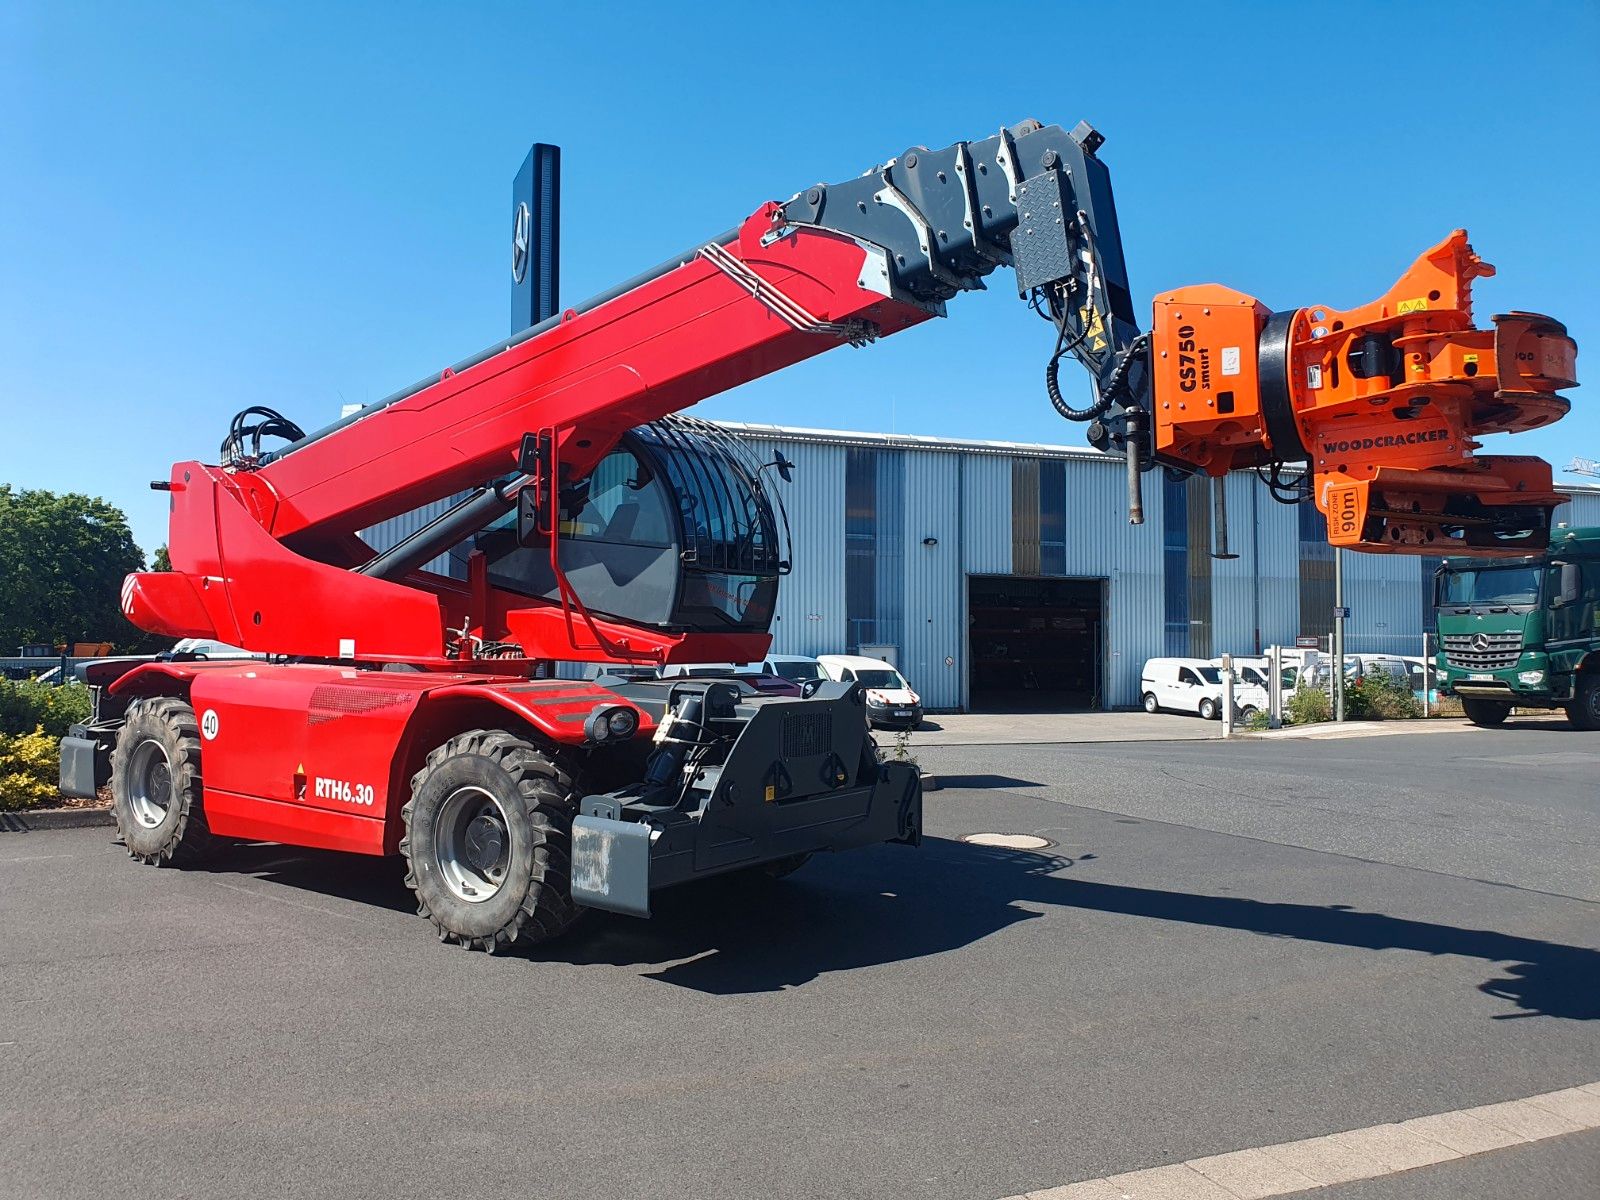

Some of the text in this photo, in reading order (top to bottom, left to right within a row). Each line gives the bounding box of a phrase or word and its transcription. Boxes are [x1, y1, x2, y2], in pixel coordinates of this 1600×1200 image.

[1178, 325, 1197, 393] CS750
[1198, 348, 1211, 390] smart
[1323, 429, 1449, 454] WOODCRACKER
[1341, 491, 1356, 532] 90m
[203, 715, 216, 735] 40
[315, 776, 374, 806] RTH6.30
